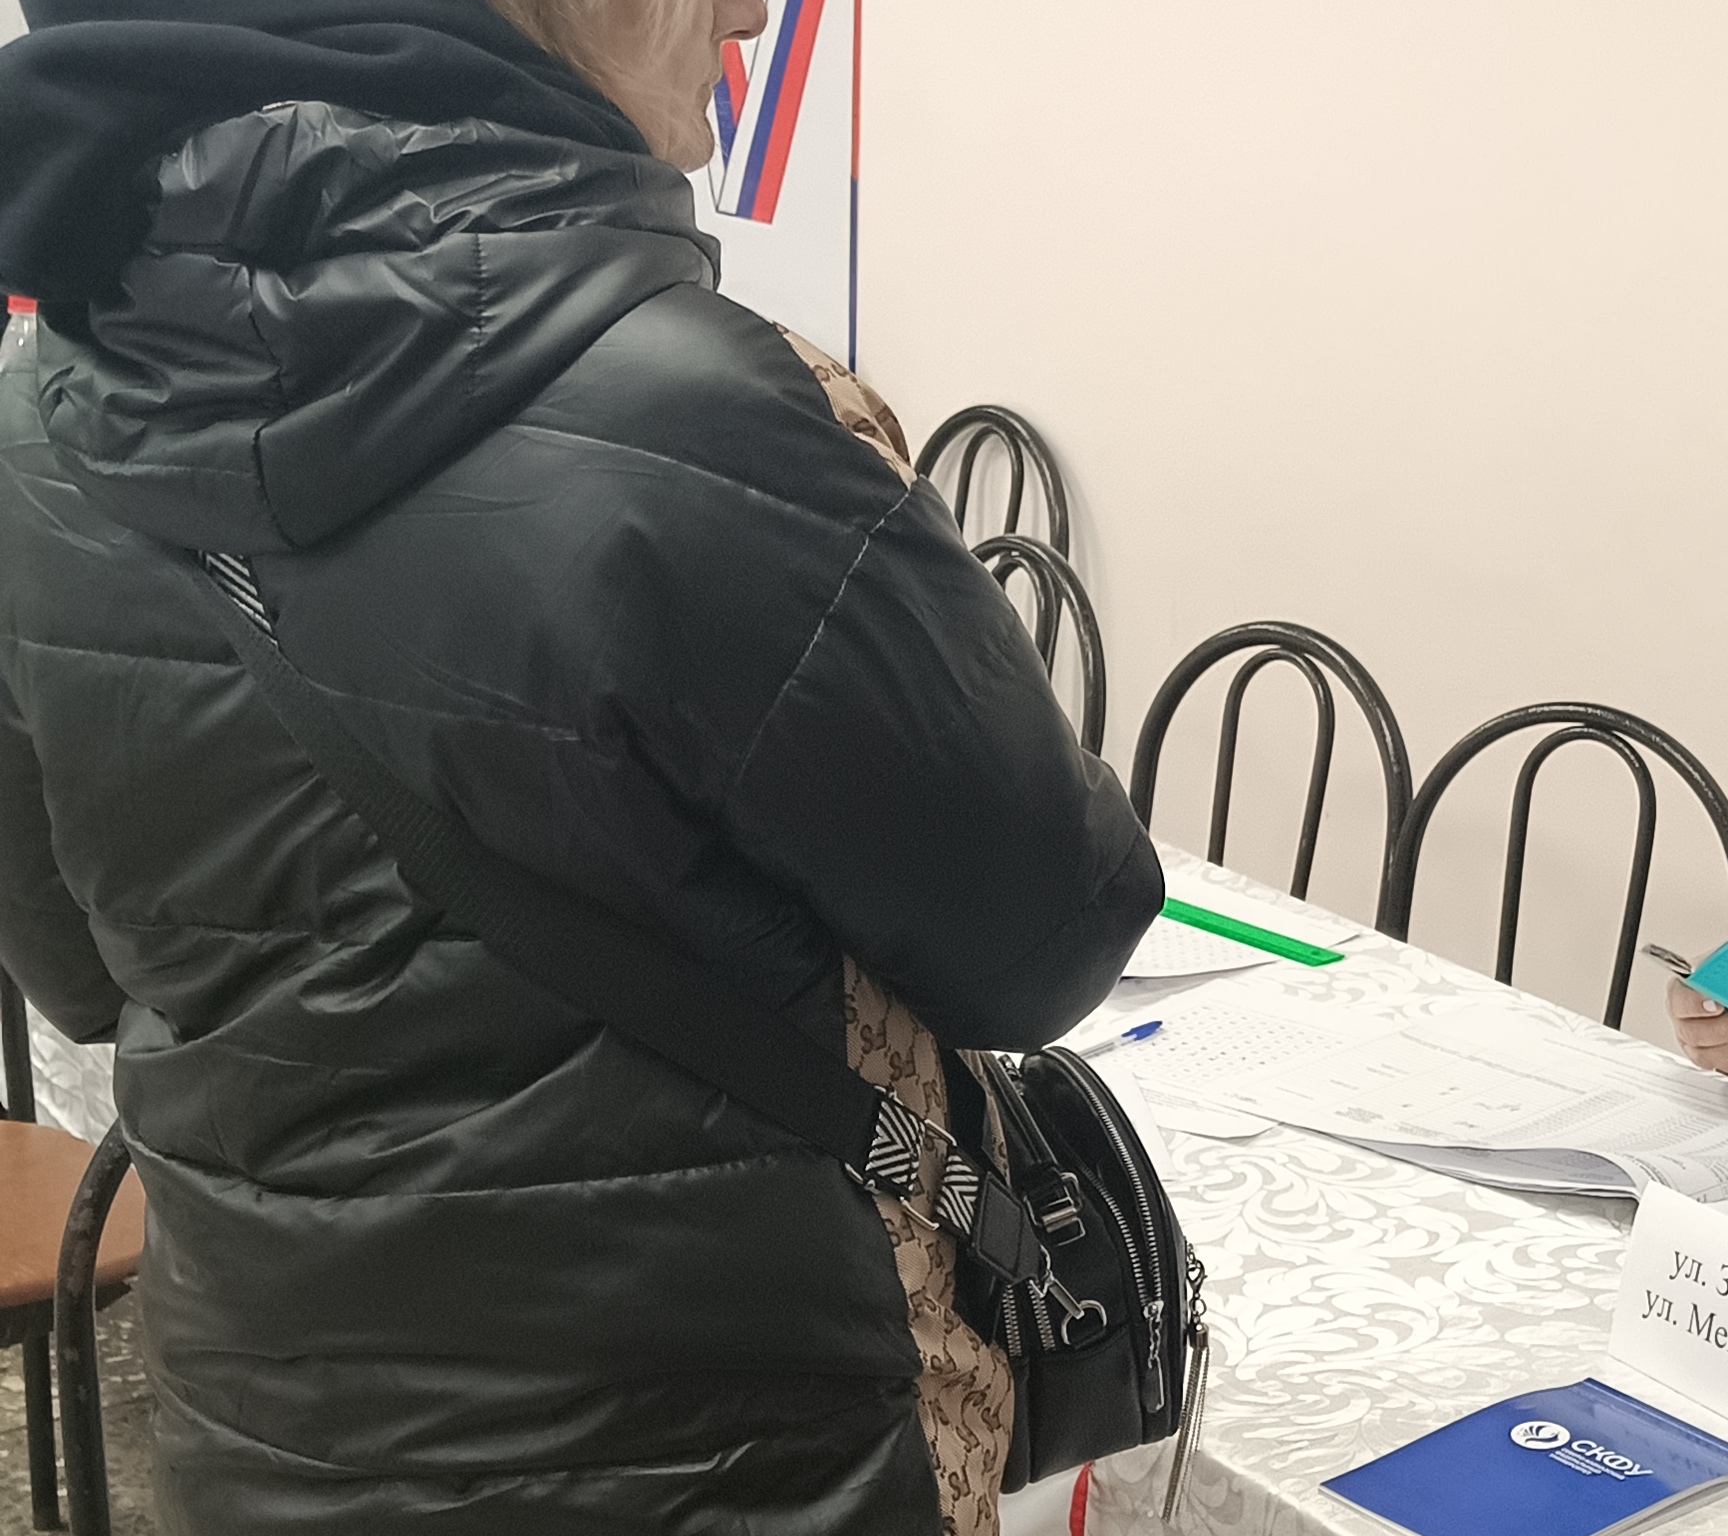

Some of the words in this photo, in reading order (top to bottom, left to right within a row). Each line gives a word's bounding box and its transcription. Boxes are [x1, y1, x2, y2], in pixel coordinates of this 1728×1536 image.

[1669, 1250, 1706, 1286] ул.
[1642, 1289, 1677, 1326] ул.
[1571, 1440, 1653, 1476] СКФУ
